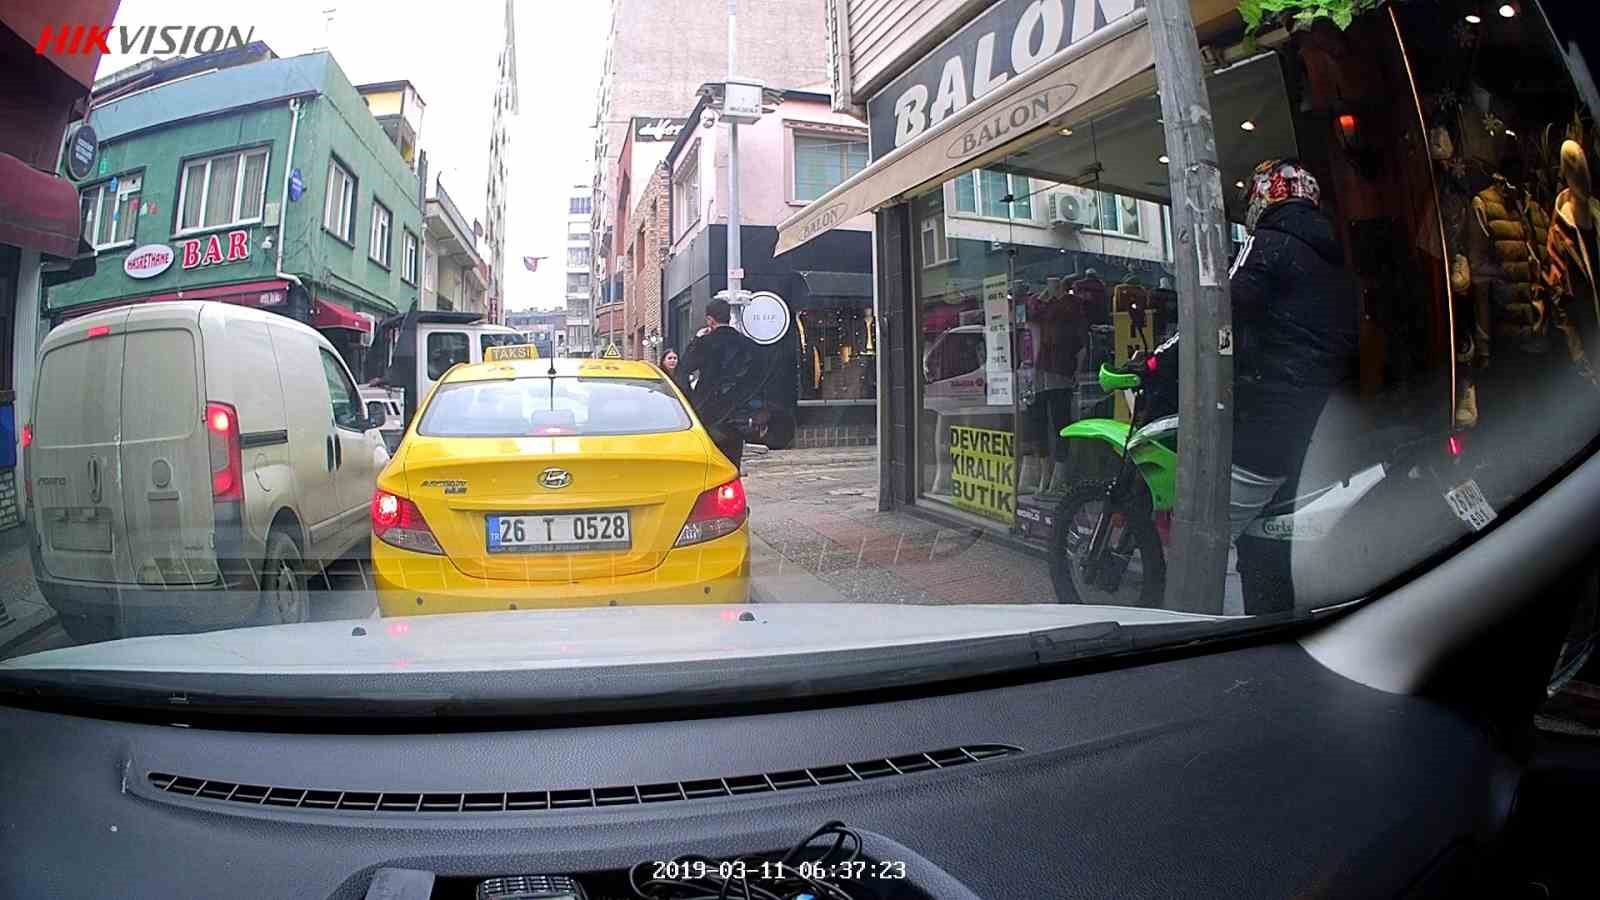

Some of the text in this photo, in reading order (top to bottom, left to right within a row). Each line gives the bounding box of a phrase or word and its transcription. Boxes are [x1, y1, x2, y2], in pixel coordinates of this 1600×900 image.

[894, 0, 1135, 148] BALON
[962, 93, 1049, 154] BALON
[800, 208, 840, 241] BALON
[182, 230, 249, 270] BAR
[950, 428, 1014, 457] DEVREN
[951, 450, 1013, 486] KİRALIK
[952, 479, 1013, 512] BUTİK
[501, 519, 525, 543] 26
[543, 518, 555, 542] T
[574, 515, 626, 541] 0528
